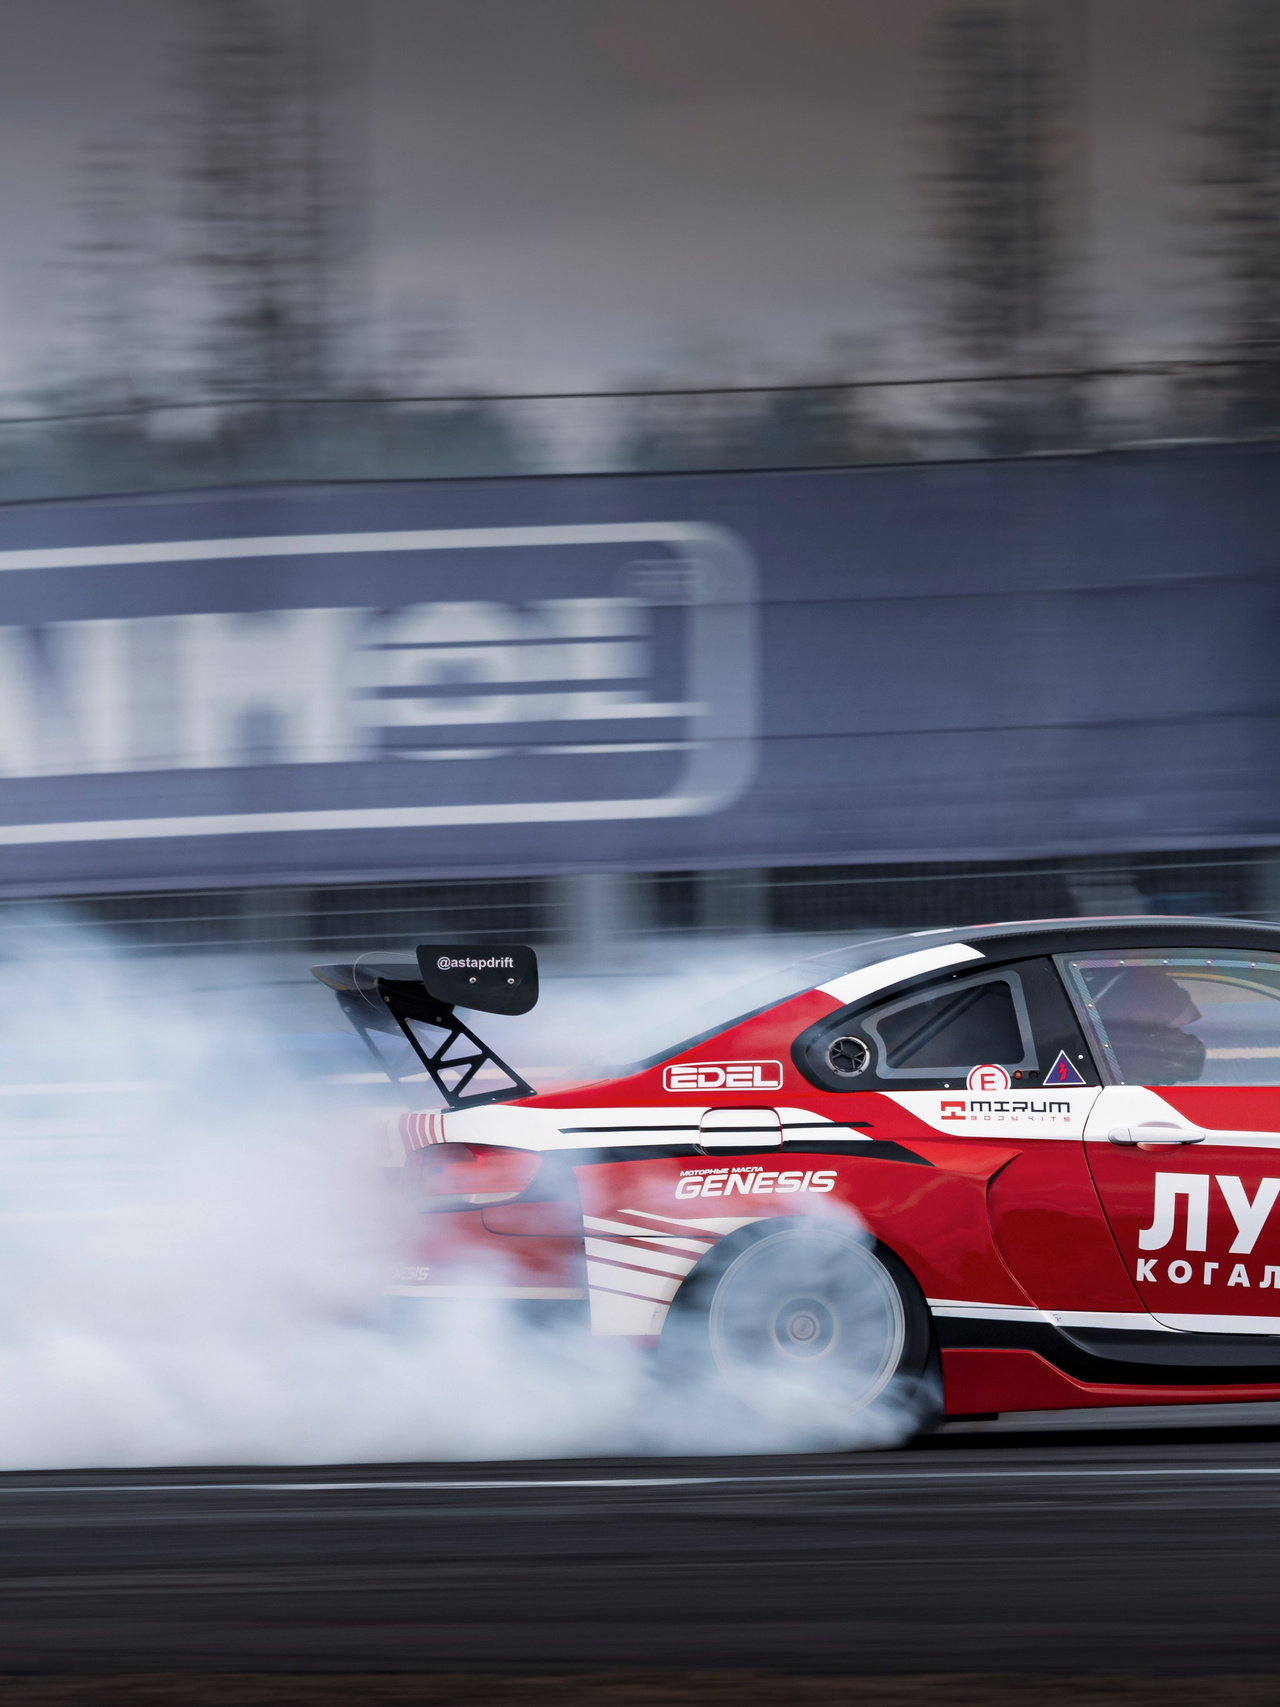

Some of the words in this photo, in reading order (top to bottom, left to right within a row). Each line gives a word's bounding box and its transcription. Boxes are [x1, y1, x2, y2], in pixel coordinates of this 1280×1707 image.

[0, 603, 708, 778] IMOL
[437, 956, 514, 970] @astapdrift
[670, 1066, 779, 1089] EDEL
[980, 1073, 997, 1091] E
[970, 1101, 1071, 1113] MIRUM
[680, 1167, 729, 1177] МОТОРНЫЕ
[675, 1171, 838, 1200] GENESIS
